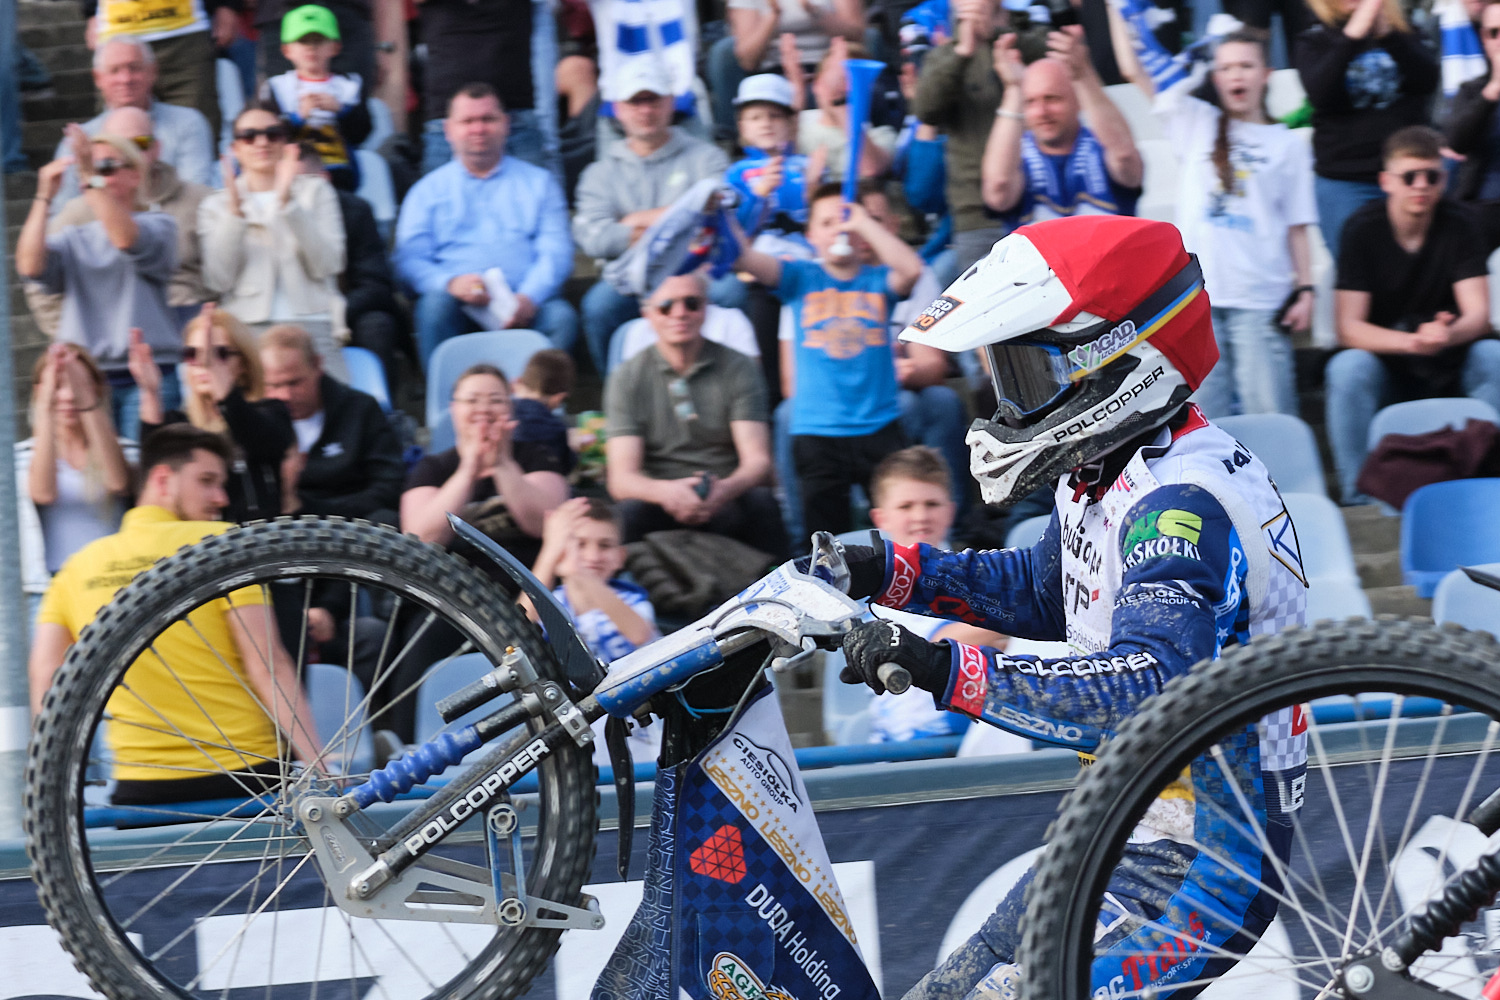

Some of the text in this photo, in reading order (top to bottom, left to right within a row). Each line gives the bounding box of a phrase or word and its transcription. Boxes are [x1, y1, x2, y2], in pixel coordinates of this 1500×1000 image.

[1101, 333, 1137, 360] IZOLACJE
[1053, 365, 1165, 443] POLCOPPER
[982, 702, 1085, 744] LESZNO
[403, 736, 552, 857] POLCOPPER
[731, 736, 800, 814] CIESIÓŁKA
[739, 756, 785, 807] AUTO GROUP
[701, 755, 858, 946] LESZNO LESZNO LESZNO
[744, 882, 793, 943] DUDA
[1120, 910, 1206, 992] Trans
